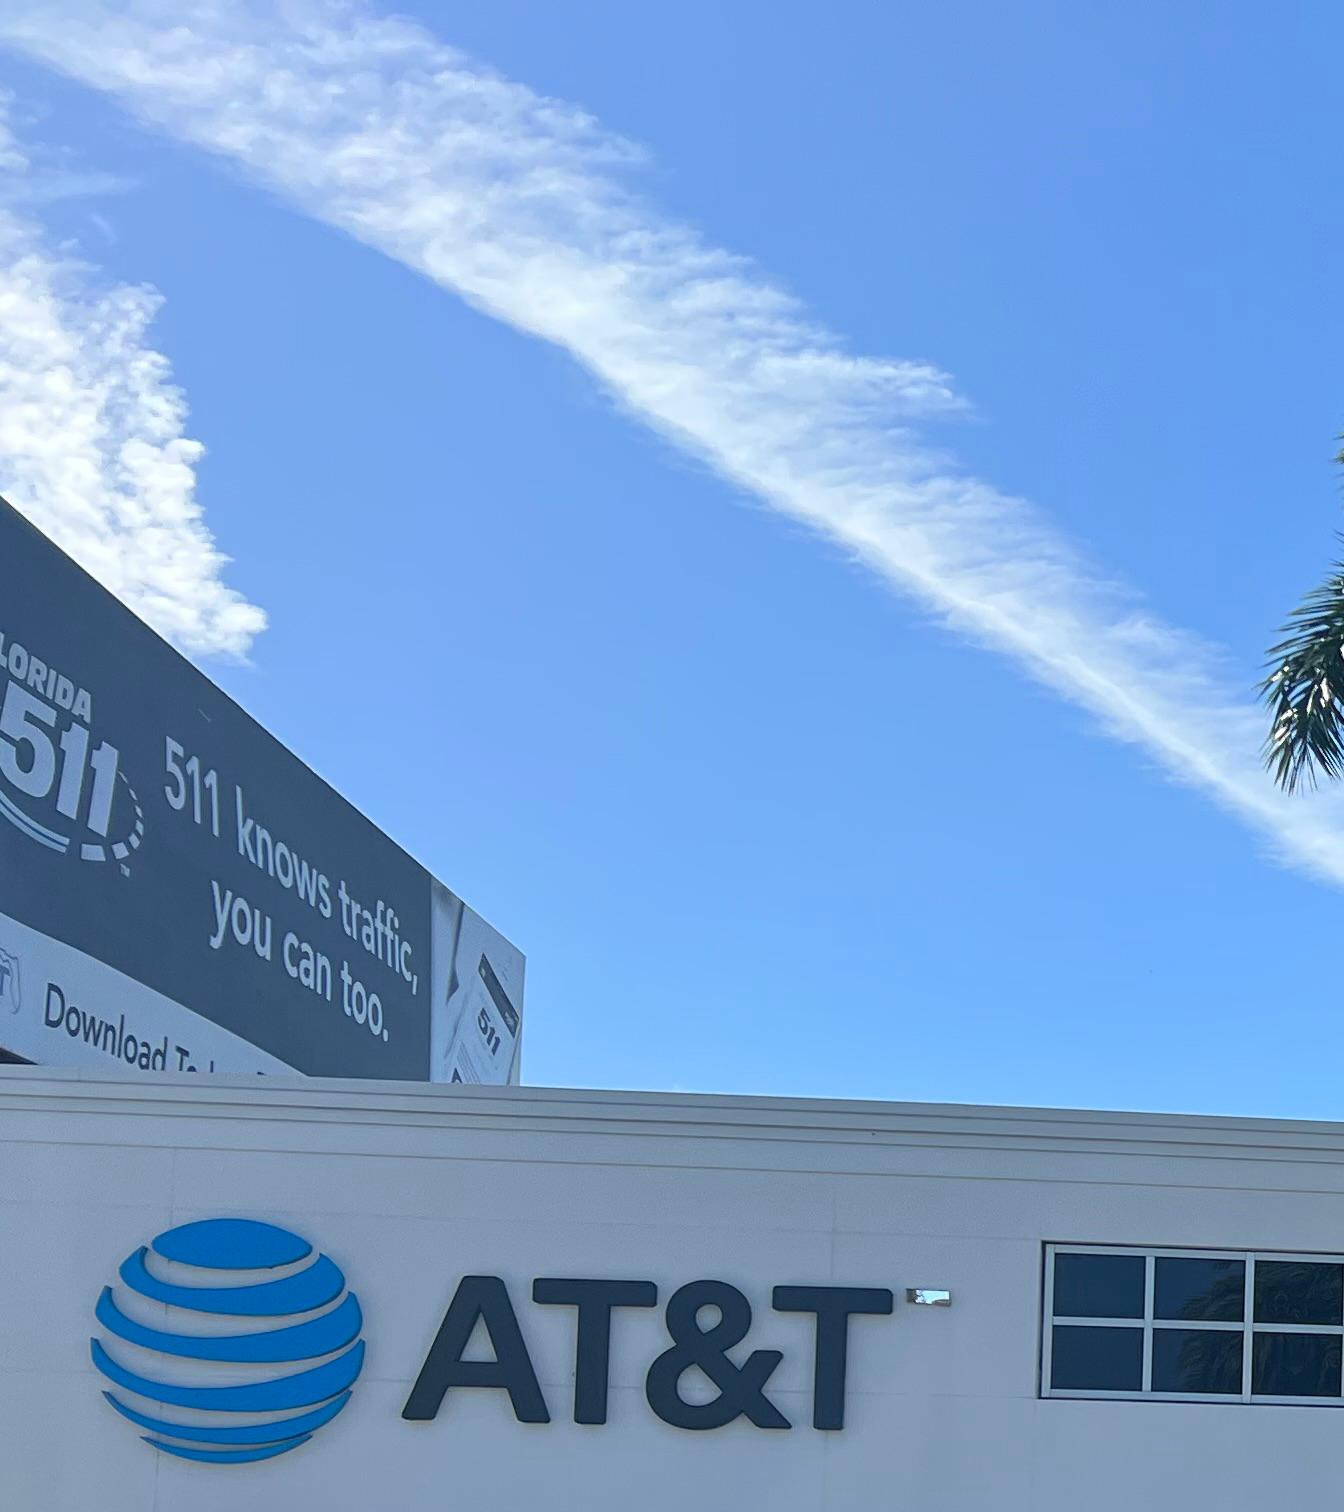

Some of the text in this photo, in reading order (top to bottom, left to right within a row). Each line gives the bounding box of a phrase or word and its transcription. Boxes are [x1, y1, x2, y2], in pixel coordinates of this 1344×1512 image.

[0, 632, 91, 724] LORIDA
[0, 680, 119, 838] 511
[164, 735, 418, 995] 511 knows traffic,
[45, 983, 168, 1071] Download
[209, 880, 389, 1042] you can too.
[478, 1008, 501, 1056] 511
[401, 1275, 894, 1431] AT&T
